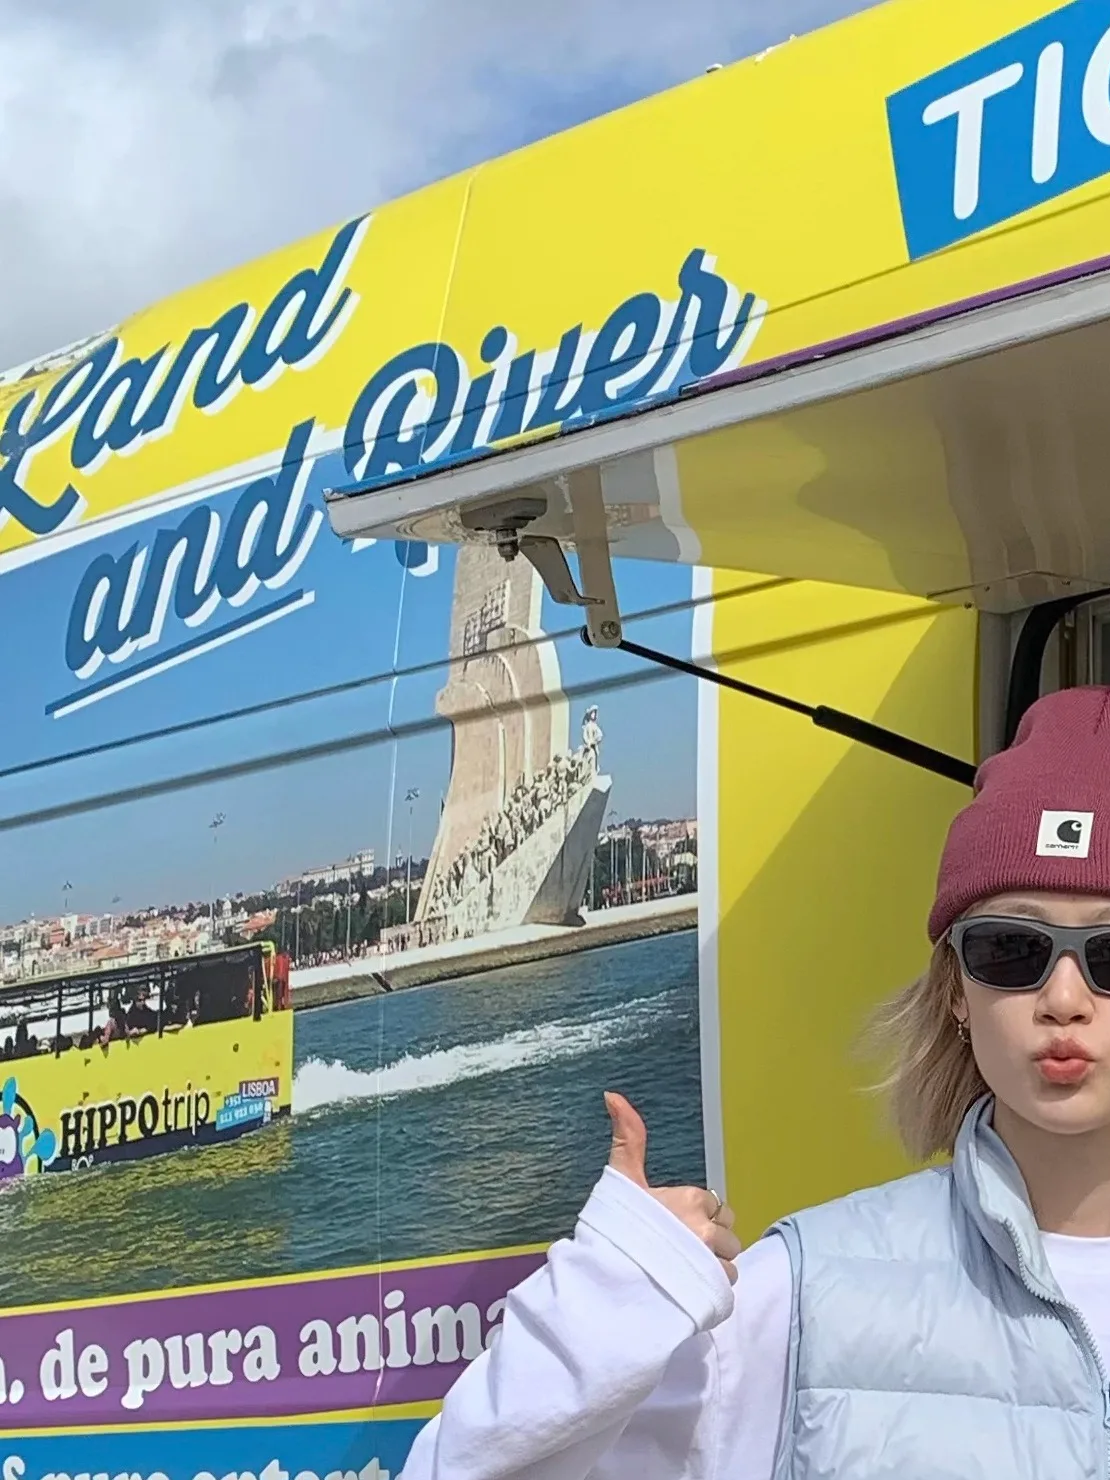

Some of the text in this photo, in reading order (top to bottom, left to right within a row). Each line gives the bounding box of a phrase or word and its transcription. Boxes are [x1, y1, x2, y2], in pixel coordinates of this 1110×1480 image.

[0, 212, 372, 536] Land
[65, 248, 765, 680] and River
[60, 1082, 211, 1157] HIPPOtrip
[242, 1079, 276, 1098] LISBOA
[40, 1329, 108, 1400] de
[121, 1325, 281, 1409] pura
